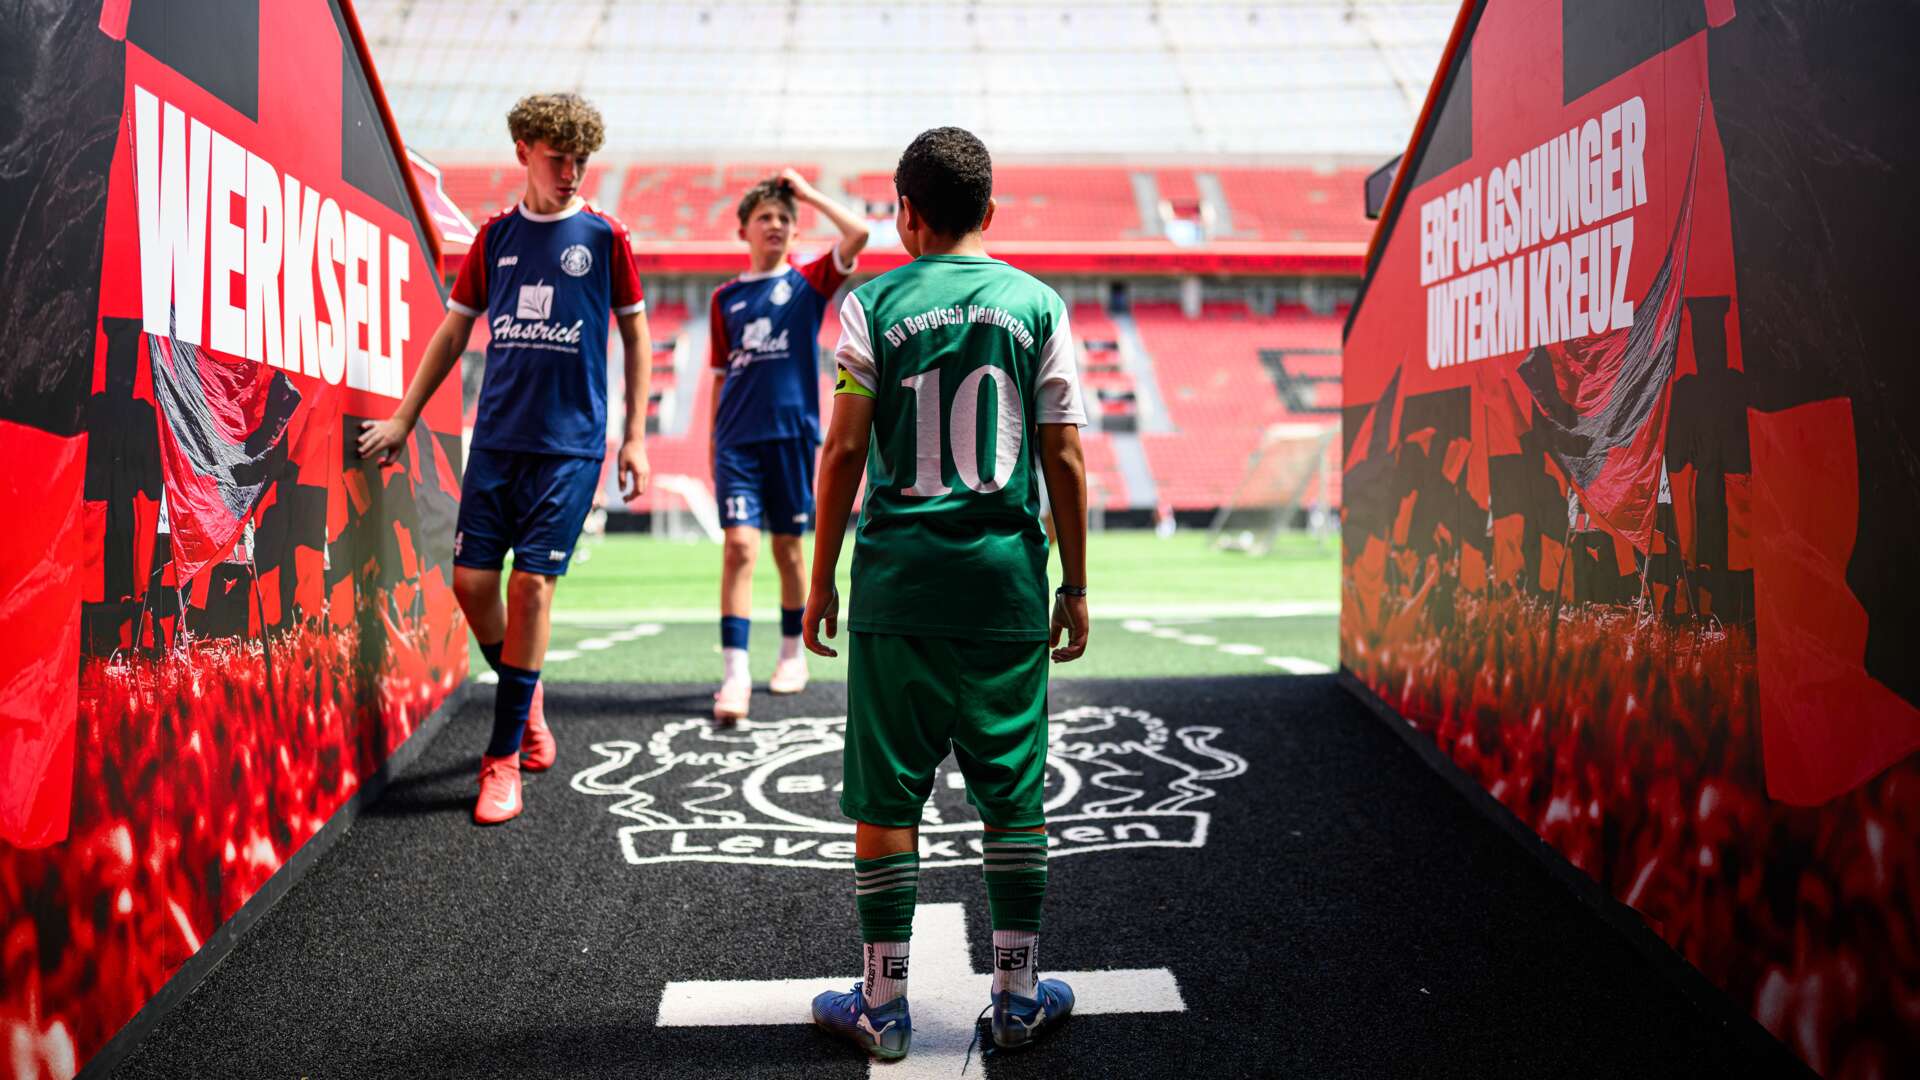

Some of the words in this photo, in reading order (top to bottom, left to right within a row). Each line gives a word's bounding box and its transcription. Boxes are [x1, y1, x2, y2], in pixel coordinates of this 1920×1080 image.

[1421, 96, 1648, 287] ERFOLGSHUNGER
[134, 83, 409, 400] WERKSELF
[1427, 256, 1525, 371] UNTERM
[1529, 216, 1634, 349] KREUZ
[493, 314, 584, 344] Hastrich
[884, 324, 908, 348] BV
[904, 304, 964, 336] Bergisch
[968, 305, 1034, 350] Neukirchen
[901, 364, 1022, 496] 10
[726, 496, 748, 520] 11
[671, 822, 1160, 859] Leveken
[998, 950, 1026, 969] FS
